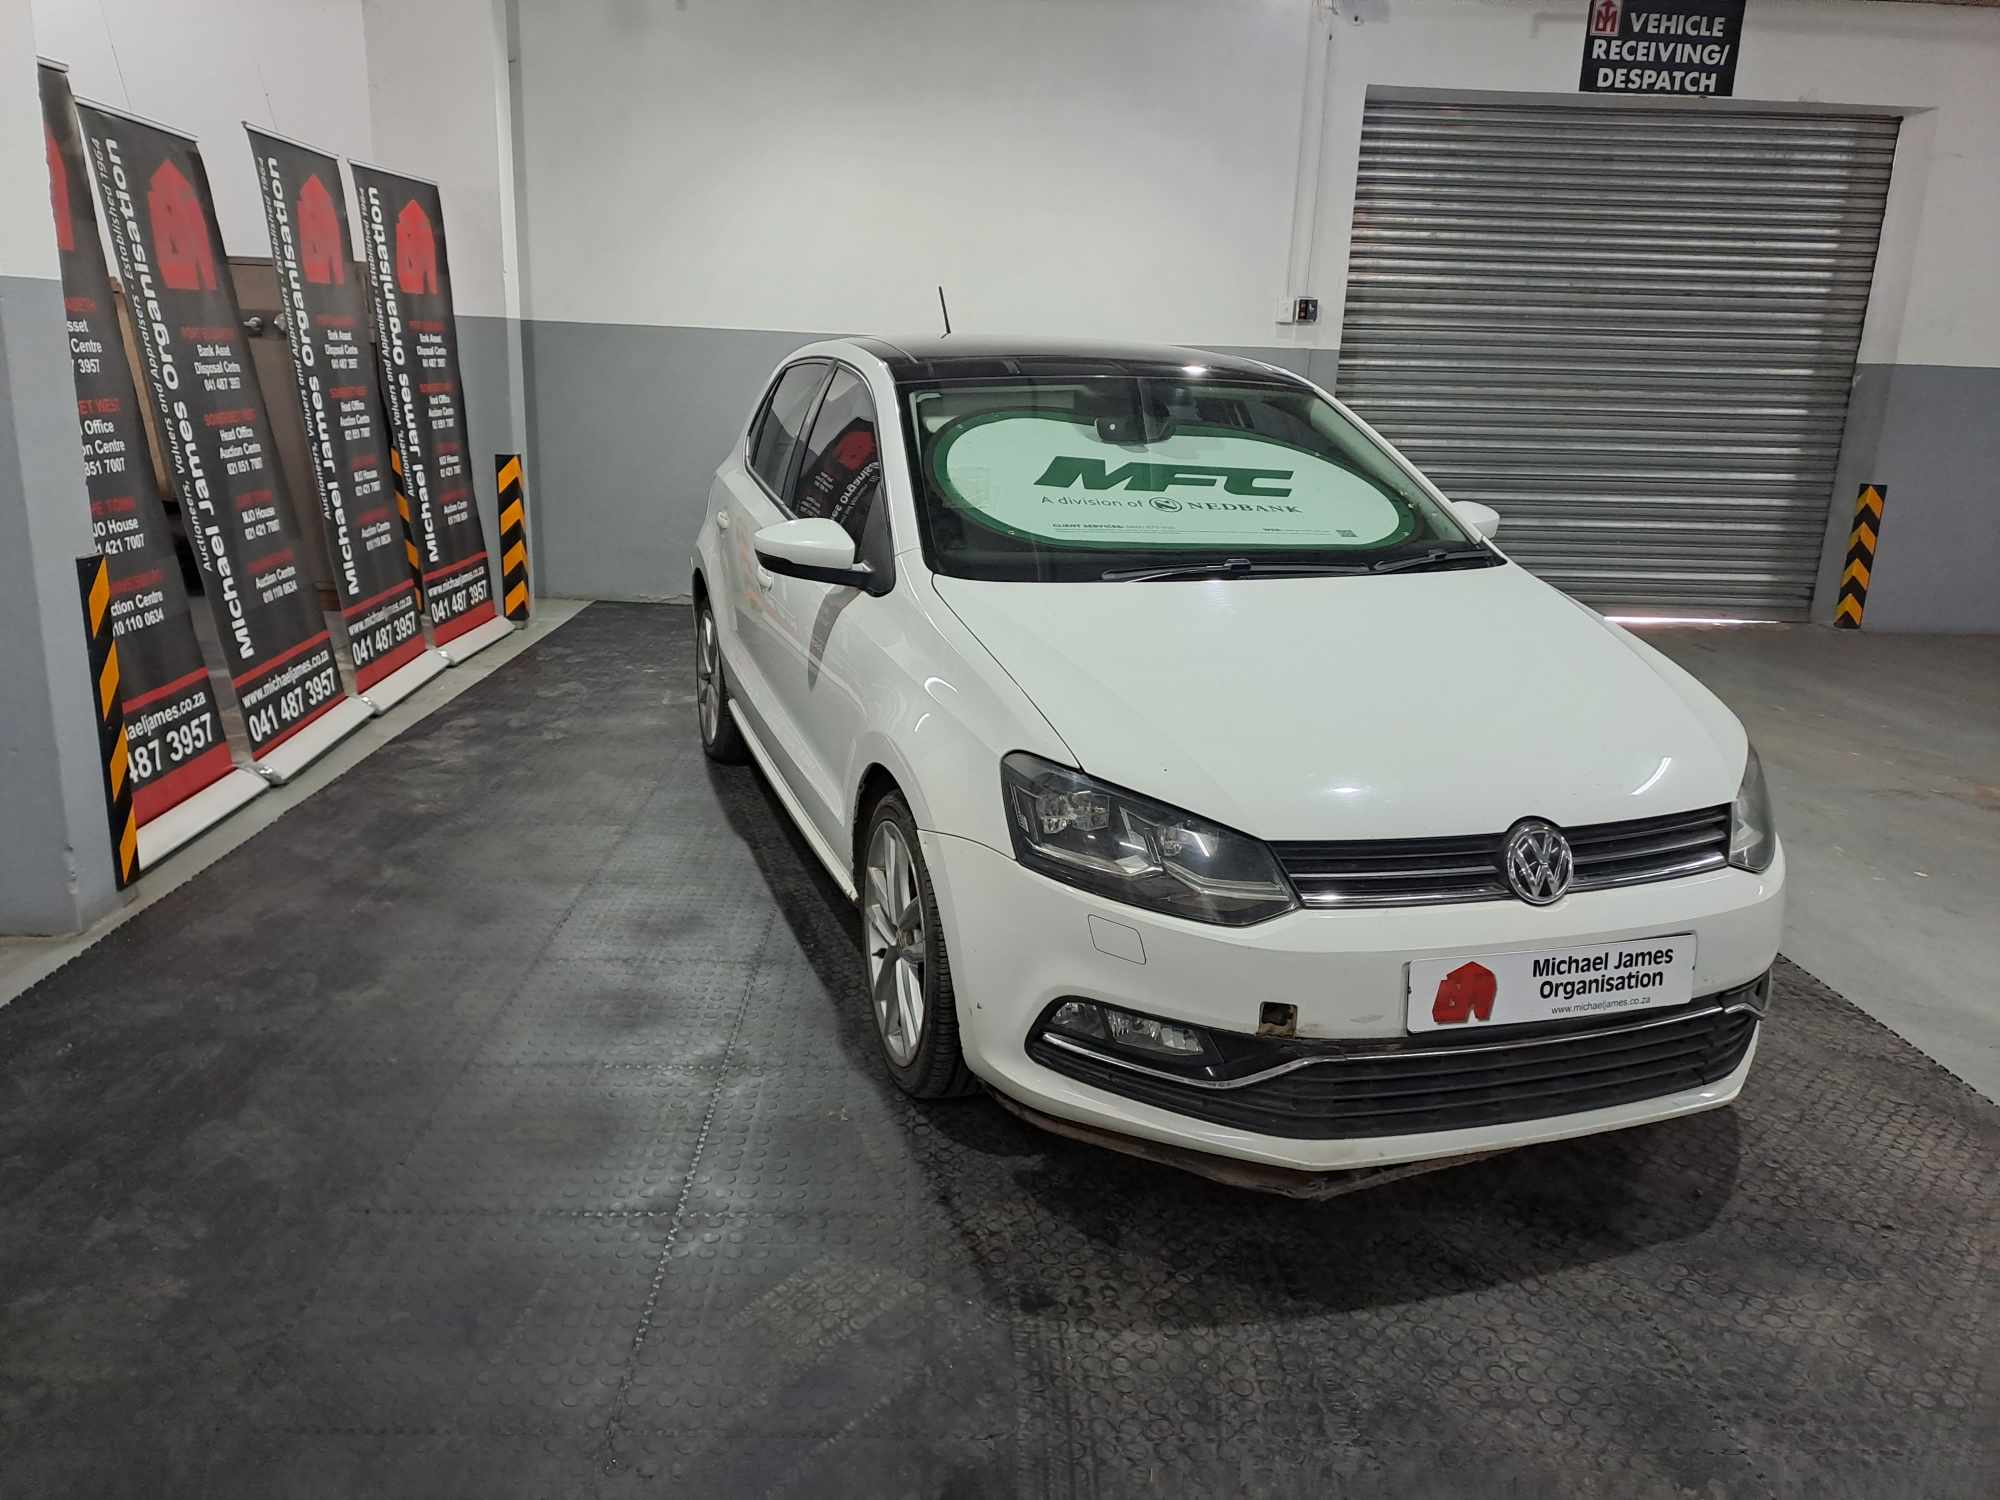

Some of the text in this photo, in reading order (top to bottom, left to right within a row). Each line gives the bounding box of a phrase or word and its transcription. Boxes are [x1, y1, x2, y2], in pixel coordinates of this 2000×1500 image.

[1630, 12, 1726, 37] VEHICLE
[1591, 38, 1730, 66] RECEIVING/
[1596, 67, 1717, 93] DESPATCH
[105, 138, 179, 390] Organisation
[267, 156, 315, 368] Organisation
[66, 319, 89, 332] sset
[131, 294, 160, 379] Appraisers
[70, 338, 103, 353] Centre
[367, 186, 440, 563] Michael James Organisation
[153, 382, 168, 414] and
[84, 419, 115, 435] Office
[308, 375, 336, 474] James
[94, 439, 126, 455] Centre
[164, 417, 185, 475] Valuers
[173, 400, 215, 517] James
[104, 457, 126, 473] 7007
[1033, 455, 1294, 497] MFC
[1041, 495, 1053, 505] A
[1058, 495, 1122, 508] division
[1127, 498, 1145, 508] of
[1188, 502, 1303, 513] NEDBANK
[106, 518, 139, 534] House
[326, 481, 360, 596] Michael
[105, 538, 124, 555] 421
[124, 533, 145, 551] 7007
[110, 590, 164, 617] ction Centre
[205, 525, 255, 660] Michael
[431, 579, 487, 624] 041 487 3957
[125, 614, 143, 632] 110
[144, 607, 165, 626] 0634
[352, 611, 416, 666] 041 487 3957
[126, 691, 206, 741] aeljames.co.za
[249, 666, 336, 742] 041 487 3957
[166, 711, 213, 762] 3957
[1532, 948, 1674, 977] Michael James
[1539, 970, 1664, 1000] Organisation
[1551, 996, 1651, 1015] www.michaeljames.co.za
